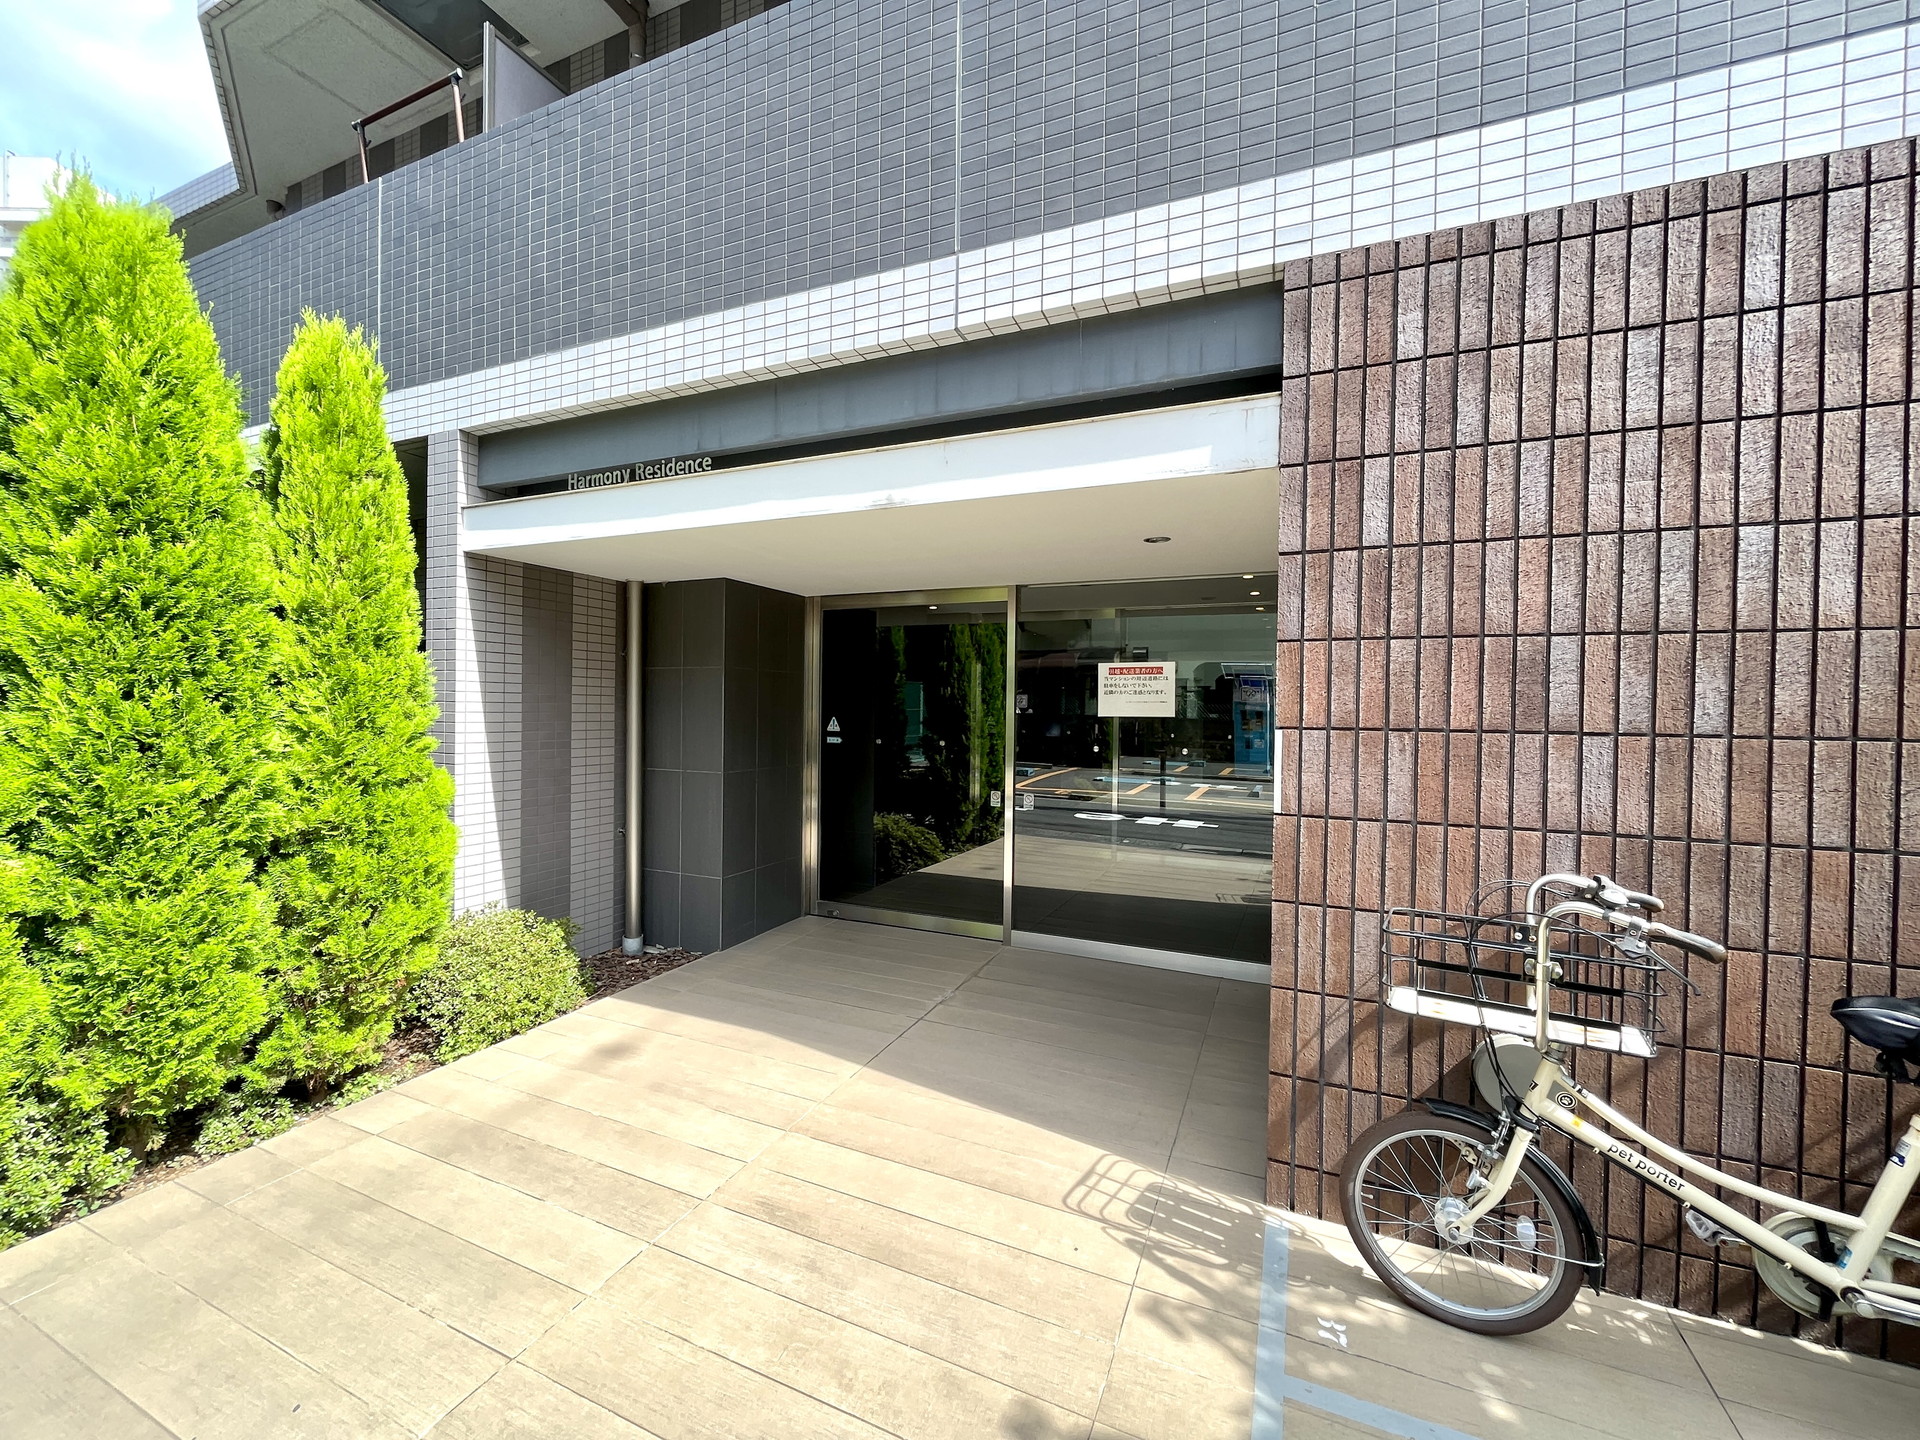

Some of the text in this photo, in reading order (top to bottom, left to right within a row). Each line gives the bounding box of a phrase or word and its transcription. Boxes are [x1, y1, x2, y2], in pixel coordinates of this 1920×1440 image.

[567, 456, 712, 490] Harmony Residence
[1607, 1144, 1686, 1191] pet porter
